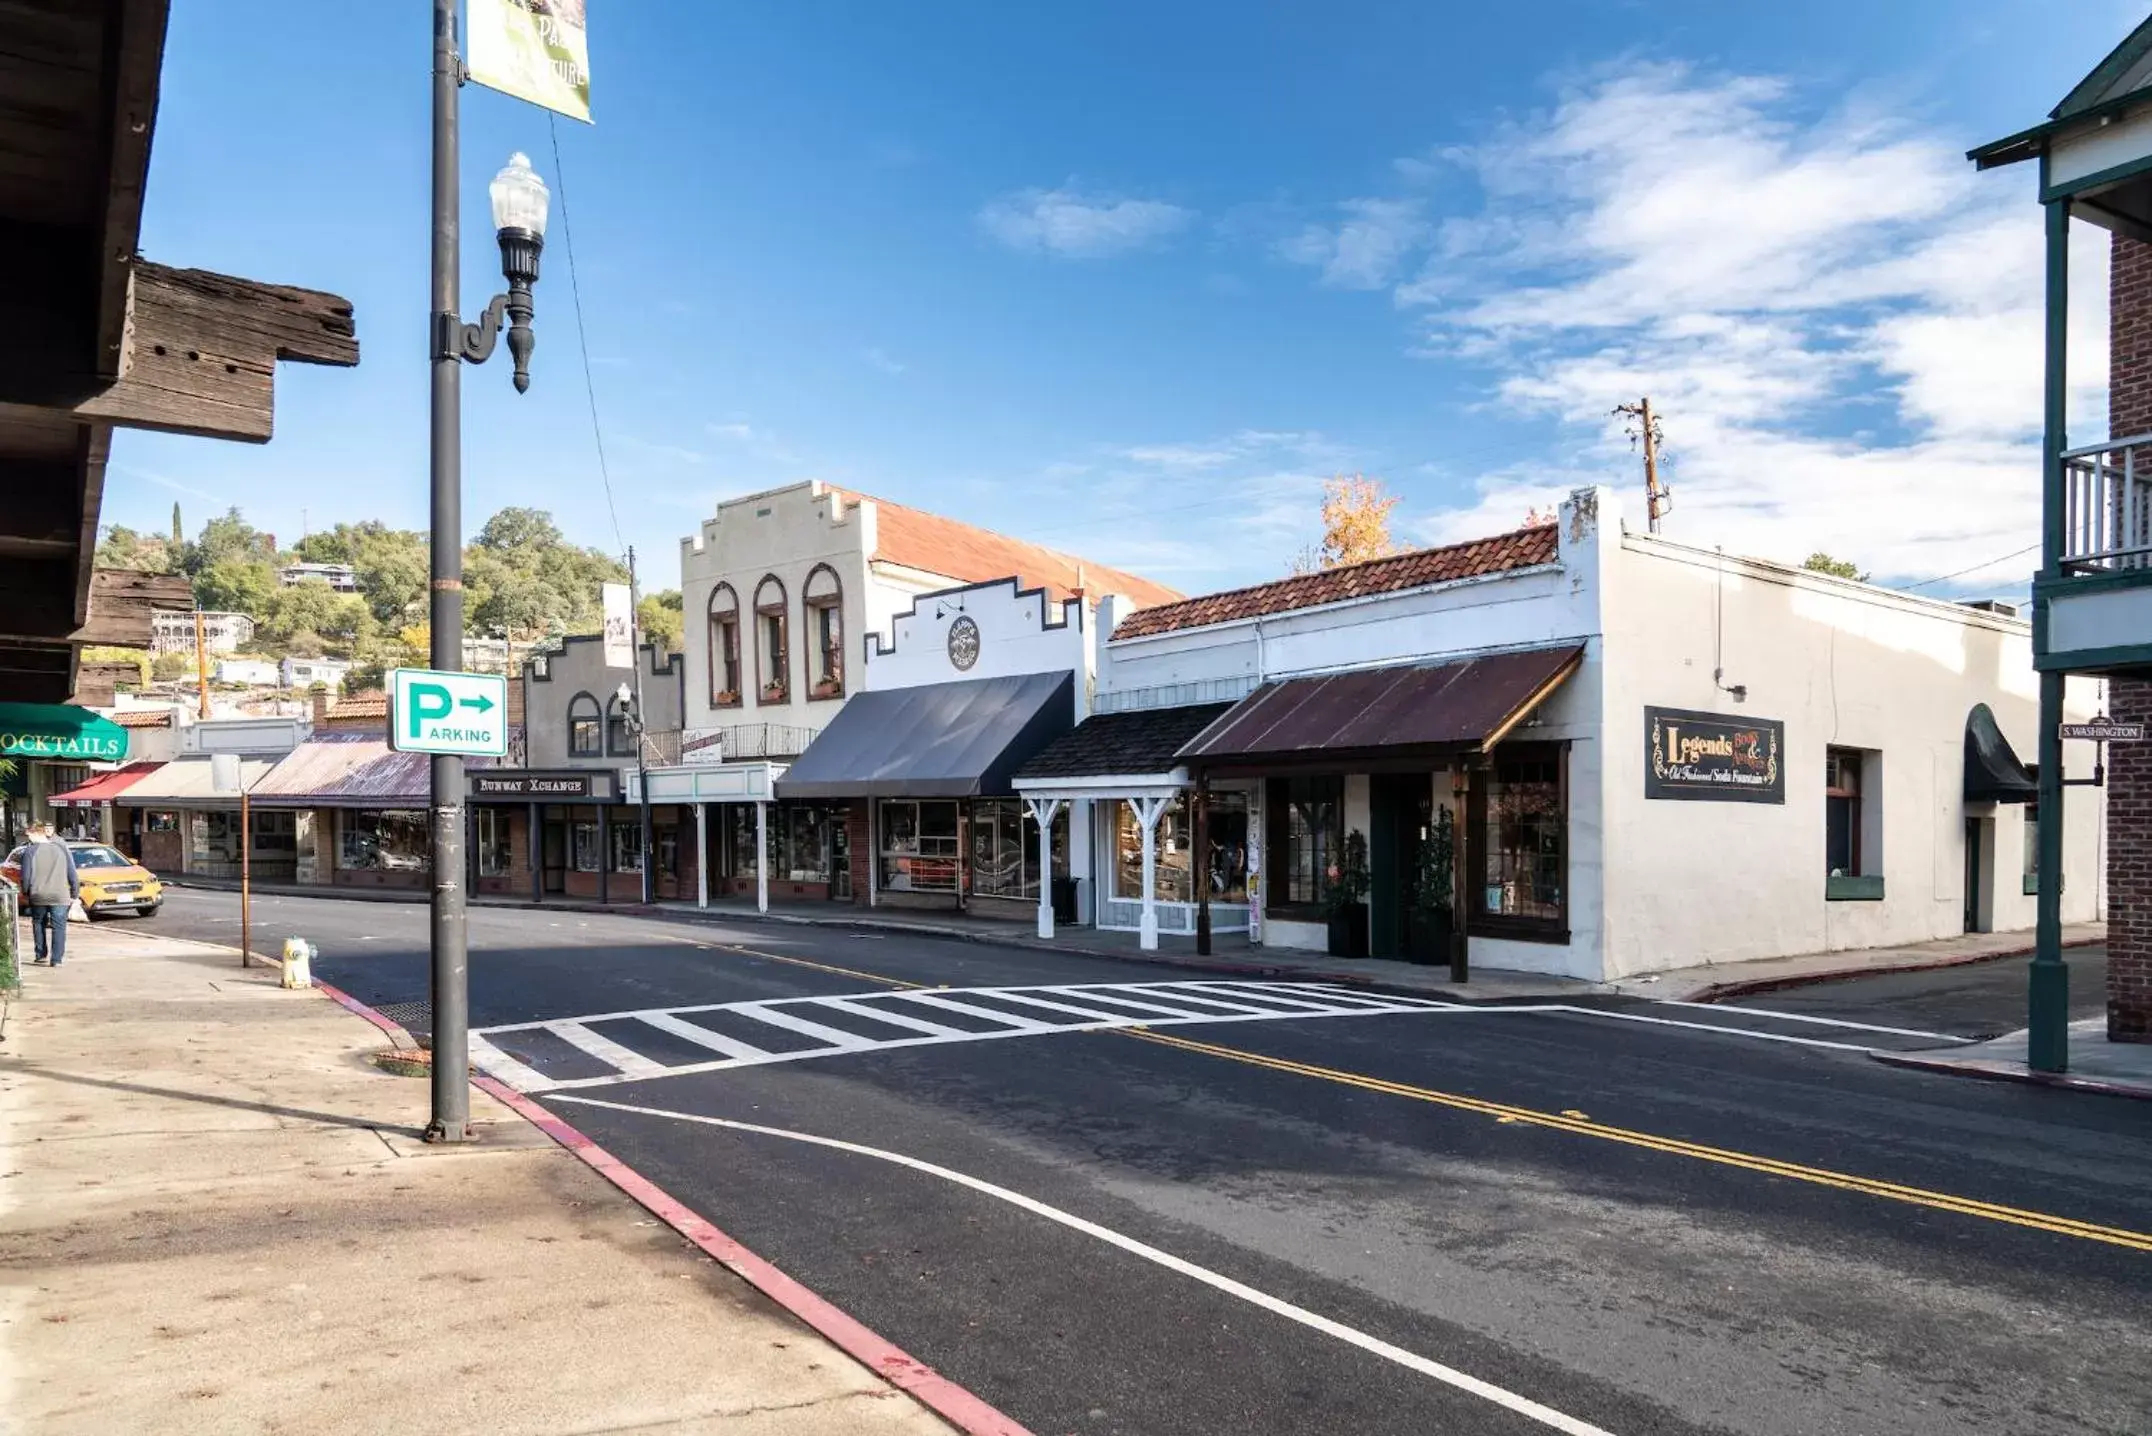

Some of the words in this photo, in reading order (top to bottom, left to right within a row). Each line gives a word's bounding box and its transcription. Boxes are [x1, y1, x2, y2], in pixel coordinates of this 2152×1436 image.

[2072, 727, 2138, 737] WASHINGTON
[1667, 727, 1733, 763] Legends
[1669, 764, 1681, 780] Old
[1713, 768, 1731, 782] Soda
[1733, 769, 1763, 783] Fountain
[479, 779, 522, 792] RUNWAY
[530, 779, 583, 792] XCHANGE
